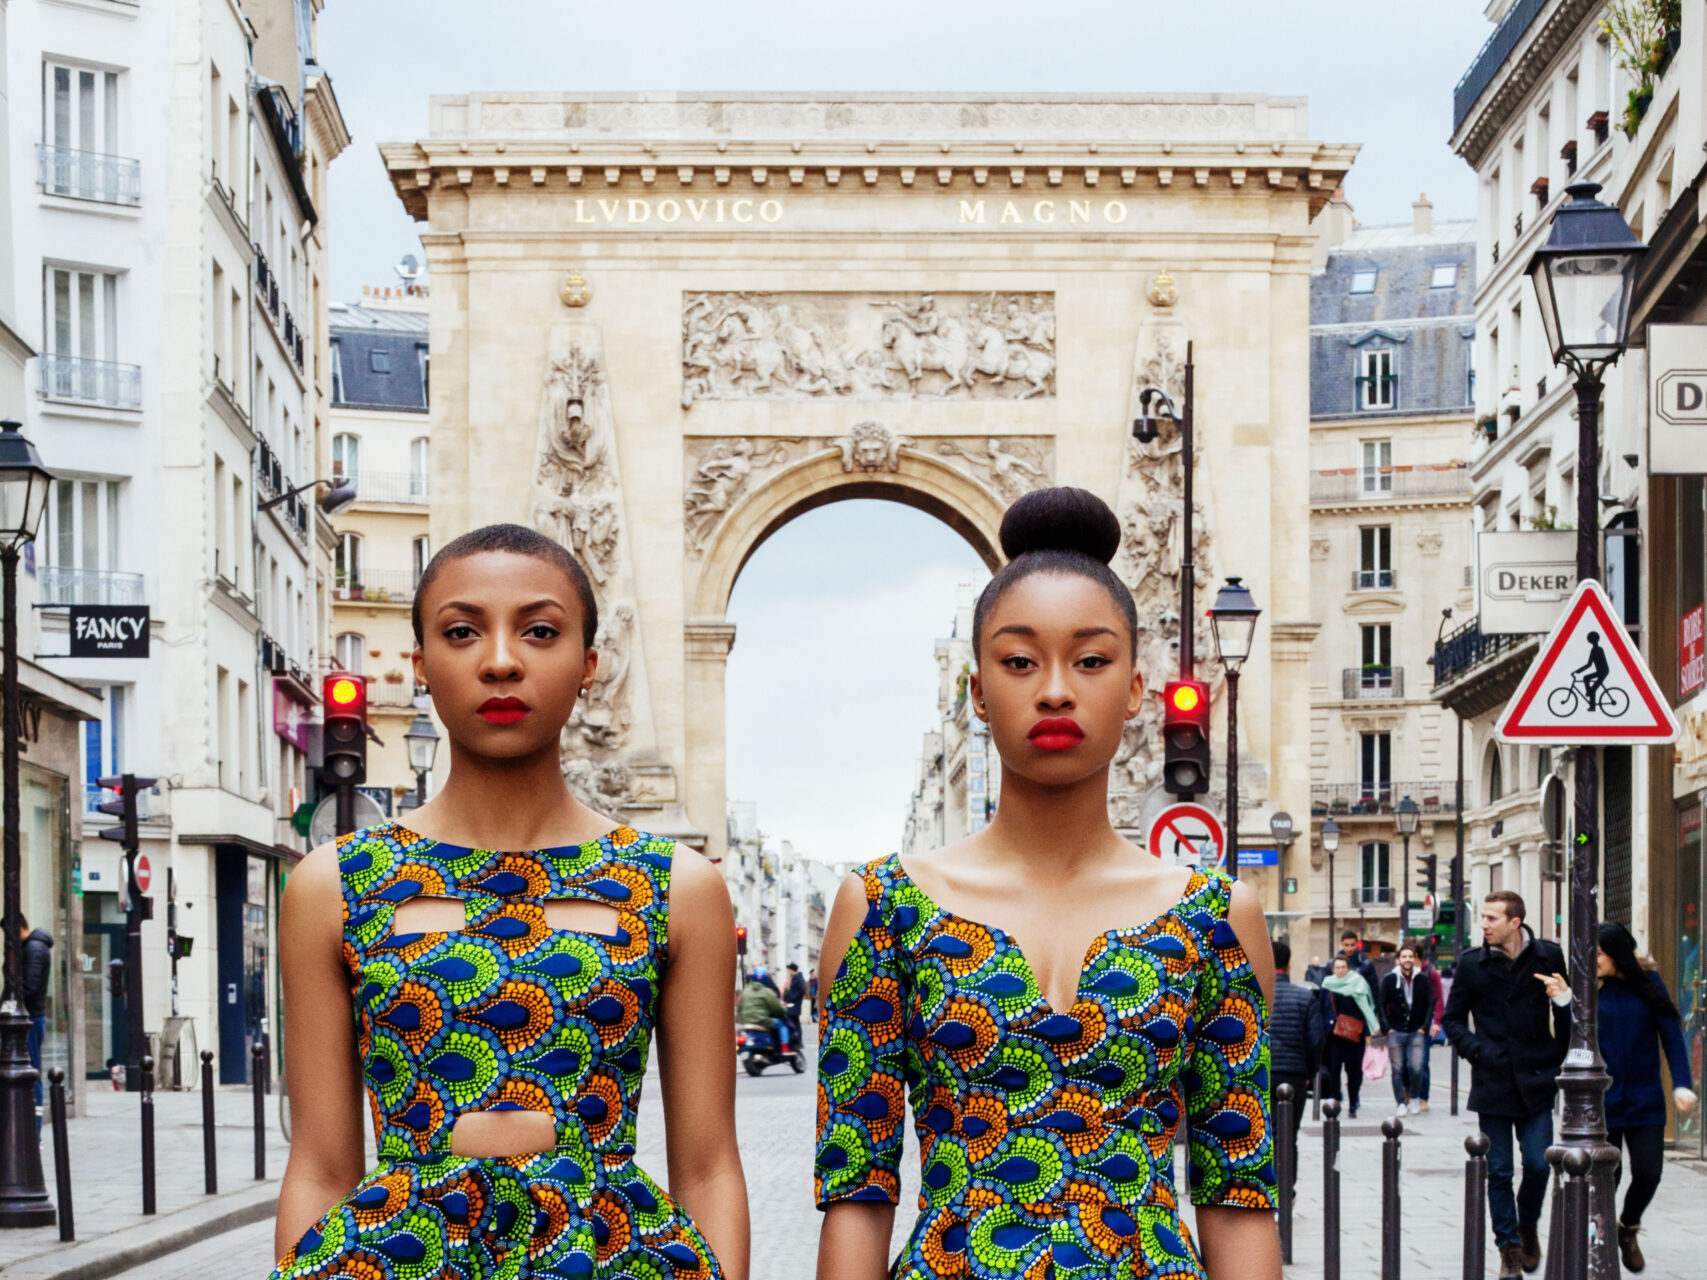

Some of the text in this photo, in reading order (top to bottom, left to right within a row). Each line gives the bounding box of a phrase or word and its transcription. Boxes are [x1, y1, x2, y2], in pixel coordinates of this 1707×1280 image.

[575, 199, 1127, 224] LVDOVICO MAGNO
[1498, 571, 1575, 591] DEKER'
[75, 616, 147, 640] FANCY
[97, 641, 123, 649] PARIS
[1272, 820, 1291, 829] TAXI
